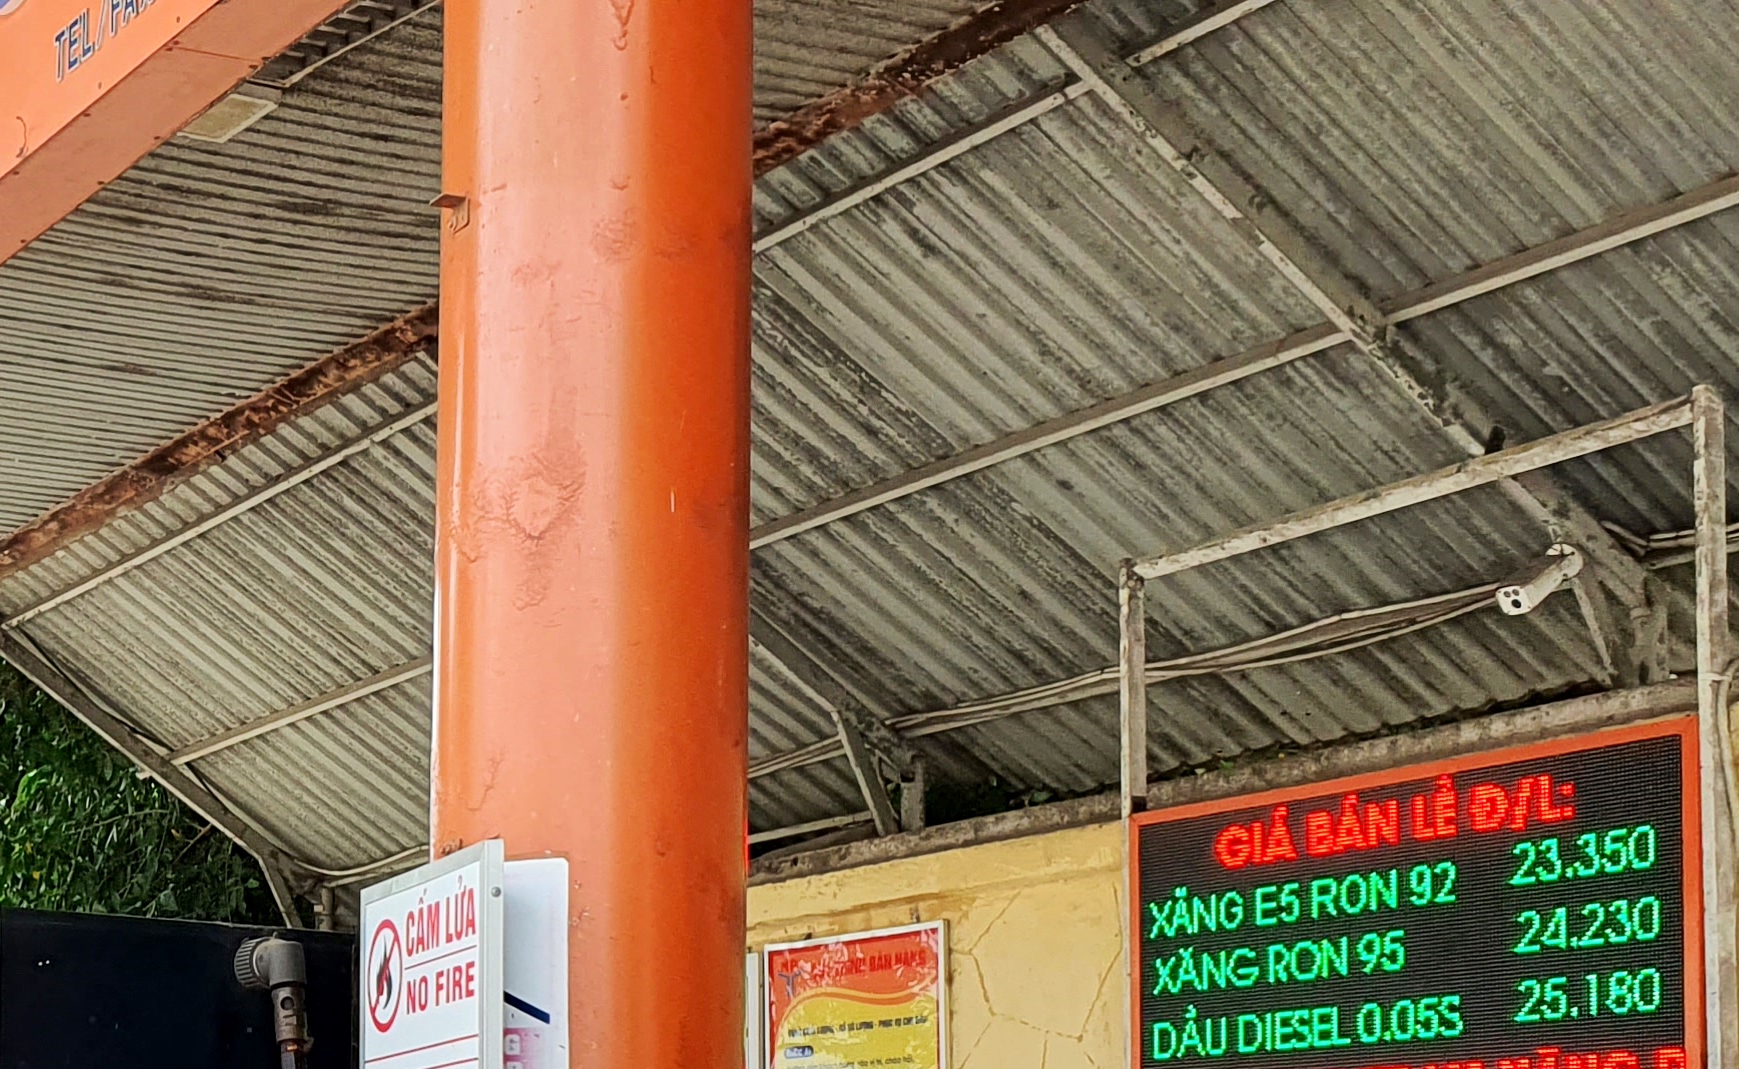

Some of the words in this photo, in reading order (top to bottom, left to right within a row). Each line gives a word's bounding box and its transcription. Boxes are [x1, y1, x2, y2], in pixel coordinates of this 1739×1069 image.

[1213, 803, 1299, 871] GIÁ
[1304, 790, 1401, 858] BÁN
[1507, 823, 1657, 887] 23.350
[405, 887, 440, 958] CẤM
[445, 874, 477, 945] LỬA
[1148, 885, 1245, 940] XĂNG
[1254, 881, 1301, 928] E5
[1310, 867, 1399, 921] RON
[1408, 860, 1458, 907] 92
[1512, 895, 1661, 955] 24.230
[406, 975, 429, 1015] NO
[435, 960, 476, 1007] FIRE
[1152, 945, 1261, 996] XĂNG
[1266, 934, 1350, 985] RON
[1356, 928, 1407, 975] 95
[1236, 1004, 1353, 1054] DIESEL
[1356, 993, 1465, 1045] 0.05S
[1512, 967, 1662, 1025] 25.180
